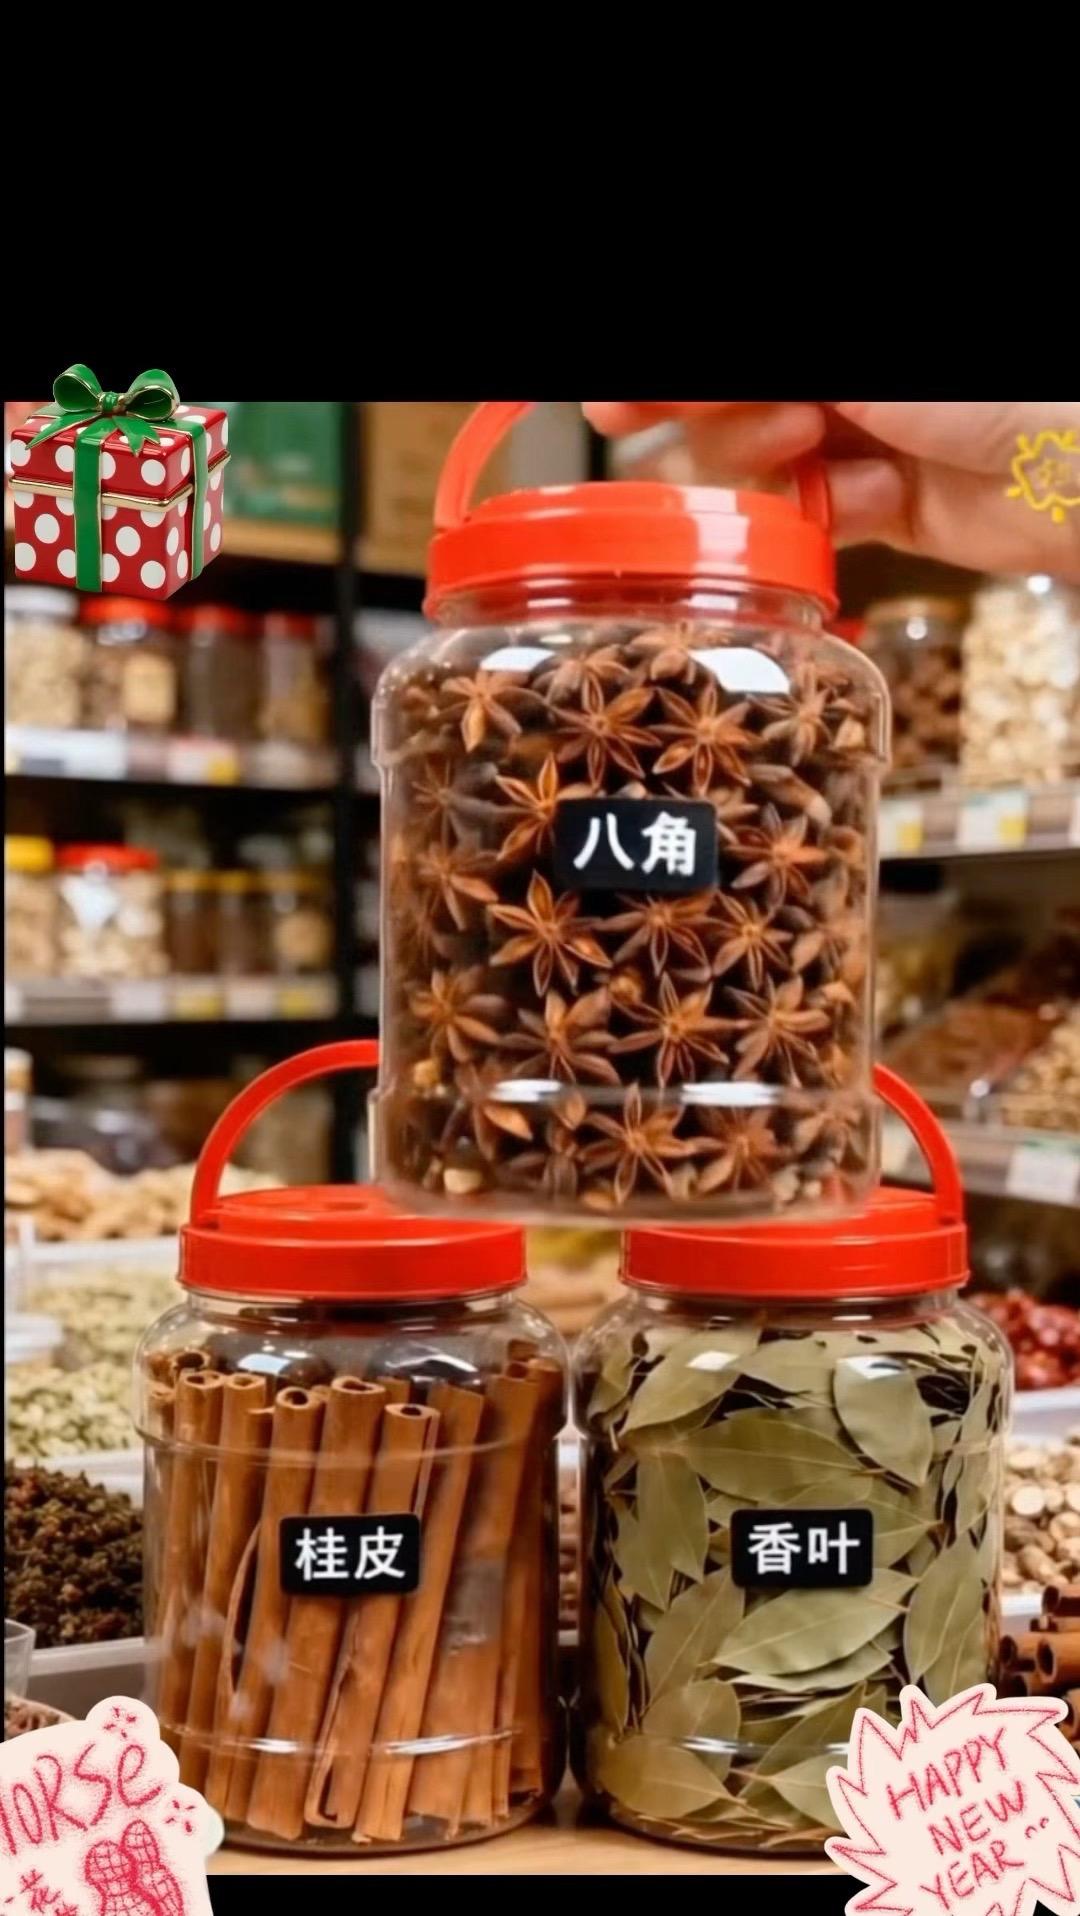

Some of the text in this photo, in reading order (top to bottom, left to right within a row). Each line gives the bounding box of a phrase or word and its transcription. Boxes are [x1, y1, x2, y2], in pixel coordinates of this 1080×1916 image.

[573, 811, 698, 877] 八角
[294, 1525, 406, 1582] 桂皮
[747, 1520, 861, 1575] 香叶
